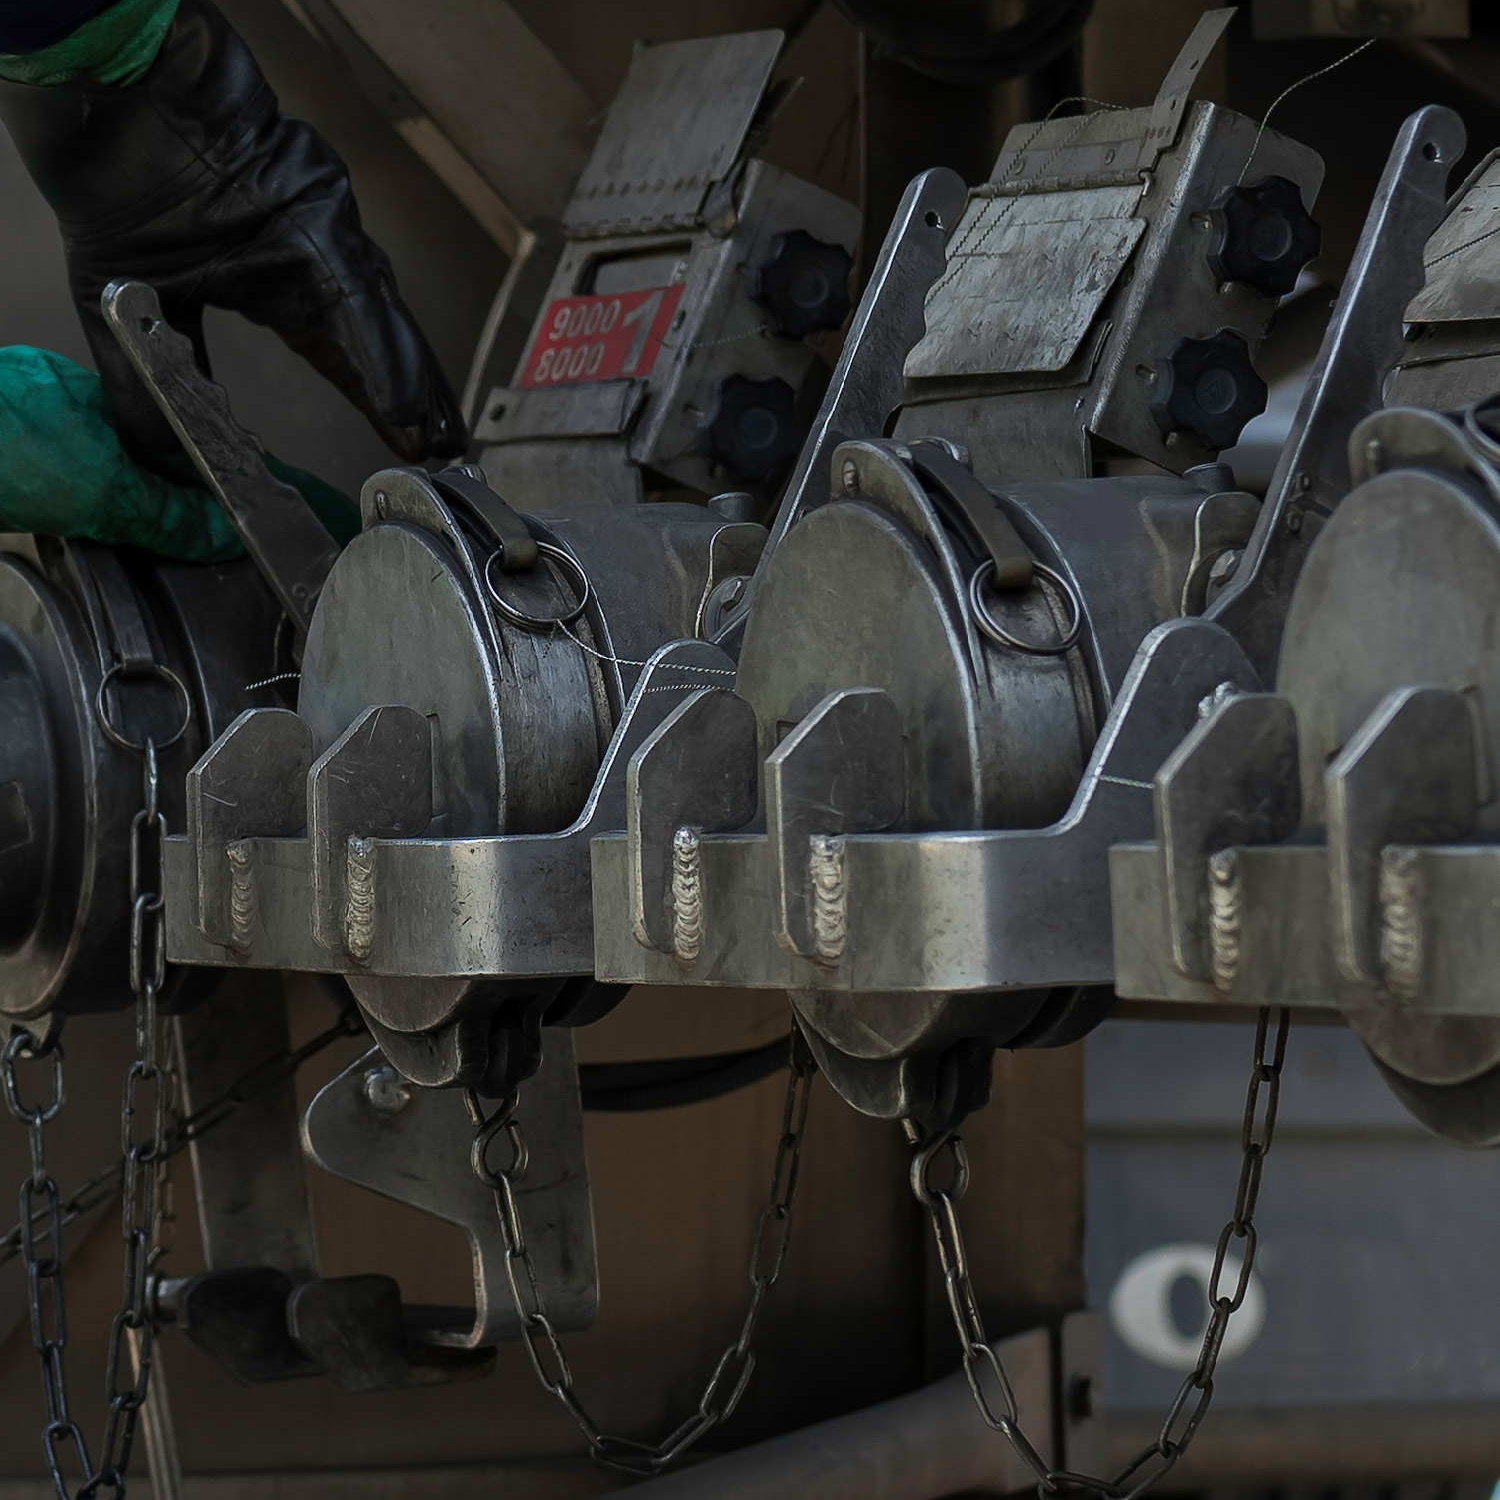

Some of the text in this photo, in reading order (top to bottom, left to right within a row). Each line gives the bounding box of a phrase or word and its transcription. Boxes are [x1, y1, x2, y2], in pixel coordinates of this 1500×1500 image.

[549, 299, 622, 341] 9000
[621, 289, 666, 375] 1
[533, 342, 606, 382] 8000
